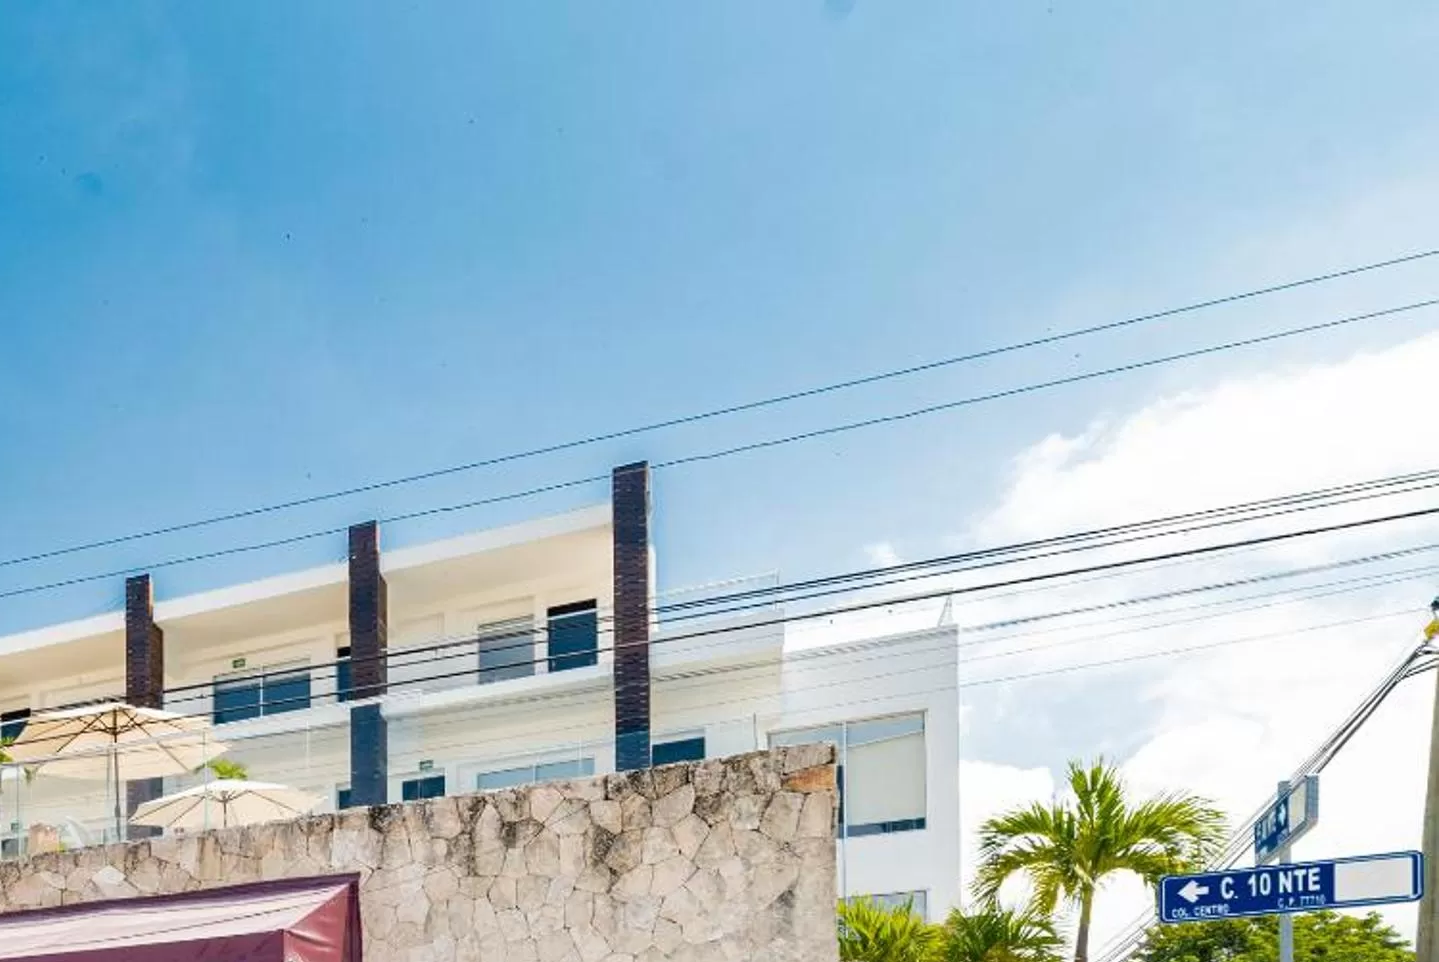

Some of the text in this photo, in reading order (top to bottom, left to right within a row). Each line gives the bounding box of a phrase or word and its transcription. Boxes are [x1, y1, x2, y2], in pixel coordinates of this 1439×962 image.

[1248, 872, 1271, 897] 10
[1278, 867, 1321, 893] NTE
[1193, 903, 1230, 917] CENTRO
